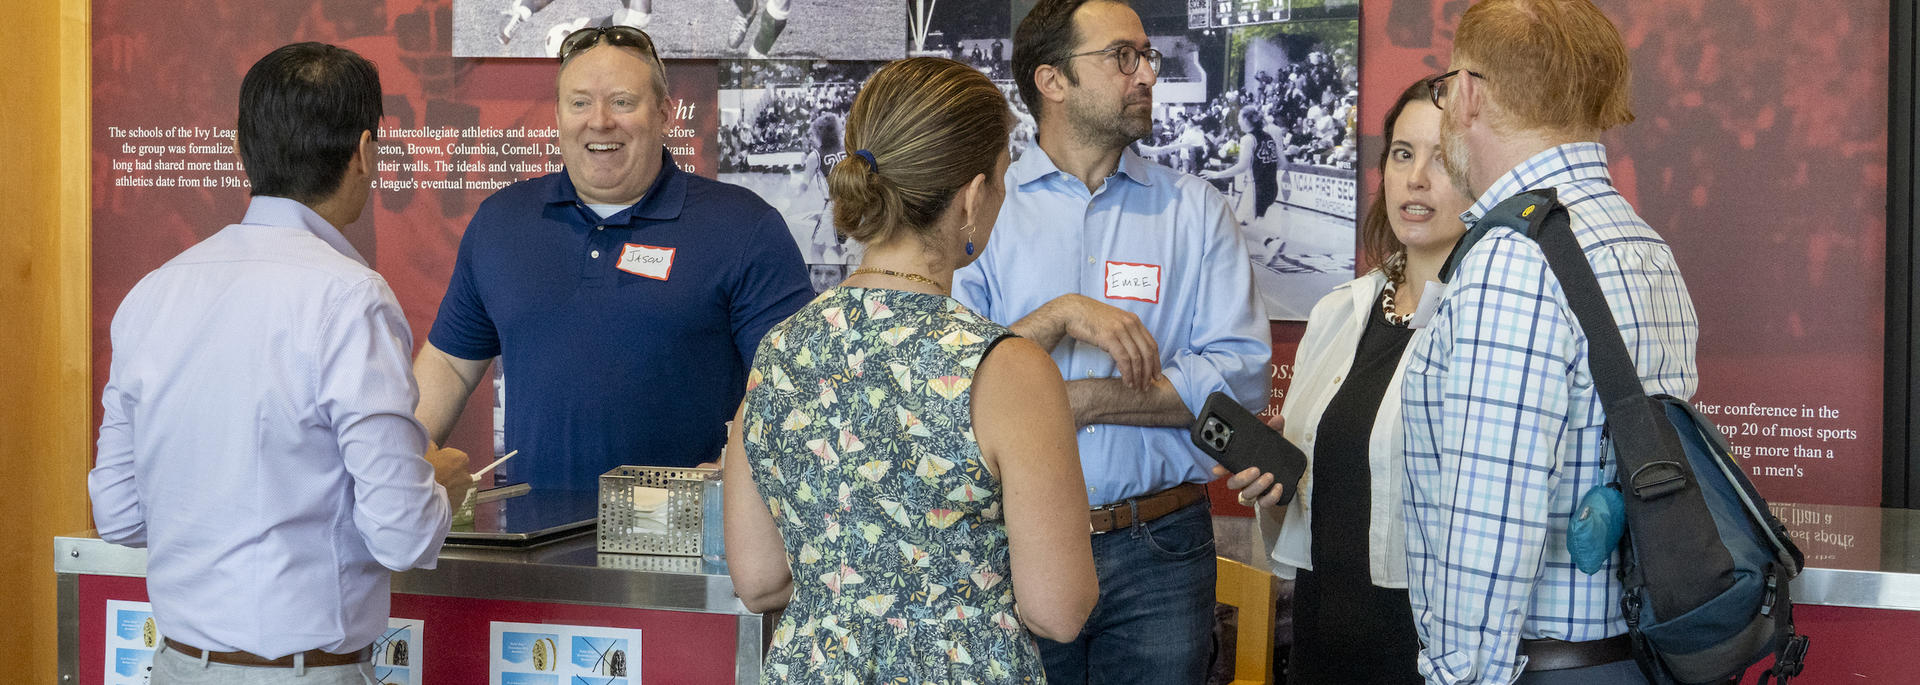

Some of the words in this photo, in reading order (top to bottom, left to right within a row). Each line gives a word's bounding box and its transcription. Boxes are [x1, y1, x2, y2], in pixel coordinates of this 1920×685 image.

[674, 99, 696, 120] ht
[108, 126, 126, 138] The
[128, 126, 163, 138] schools
[165, 126, 175, 138] of
[178, 126, 192, 138] the
[194, 126, 210, 140] Ivy
[213, 126, 238, 140] Leag
[377, 126, 386, 138] th
[390, 126, 459, 140] intercollegiate
[462, 126, 503, 138] athletics
[506, 126, 524, 138] and
[668, 126, 695, 138] efore
[122, 142, 136, 154] the
[139, 145, 165, 156] group
[168, 146, 186, 154] was
[189, 142, 234, 154] formalize
[408, 143, 444, 156] Brown,
[447, 143, 498, 156] Columbia,
[502, 143, 542, 156] Cornell,
[546, 143, 562, 154] Da
[667, 144, 695, 155] ania
[113, 159, 132, 172] long
[135, 159, 152, 170] had
[154, 159, 184, 170] shared
[187, 162, 211, 170] more
[213, 159, 234, 170] than
[377, 160, 400, 171] their
[403, 160, 431, 172] walls.
[434, 160, 454, 172] The
[457, 160, 485, 172] ideals
[488, 160, 506, 172] and
[510, 160, 542, 172] values
[685, 163, 695, 173] to
[116, 176, 153, 187] athletics
[156, 176, 175, 187] date
[178, 176, 200, 187] from
[203, 176, 217, 187] the
[221, 176, 240, 187] 19th
[380, 178, 418, 191] league's
[421, 178, 462, 189] eventual
[1112, 272, 1151, 288] EMRE
[1695, 401, 1720, 414] ther
[1724, 402, 1797, 417] conference
[1801, 404, 1814, 418] in
[1818, 406, 1839, 418] the
[1261, 404, 1279, 416] eld
[1716, 423, 1737, 438] top
[1741, 422, 1758, 436] 20
[1762, 424, 1778, 436] of
[1780, 426, 1812, 438] most
[1817, 428, 1856, 442] sports
[1731, 442, 1751, 458] ing
[1755, 446, 1789, 457] more
[1793, 445, 1822, 458] than
[1826, 449, 1834, 459] a
[1765, 465, 1803, 477] men's
